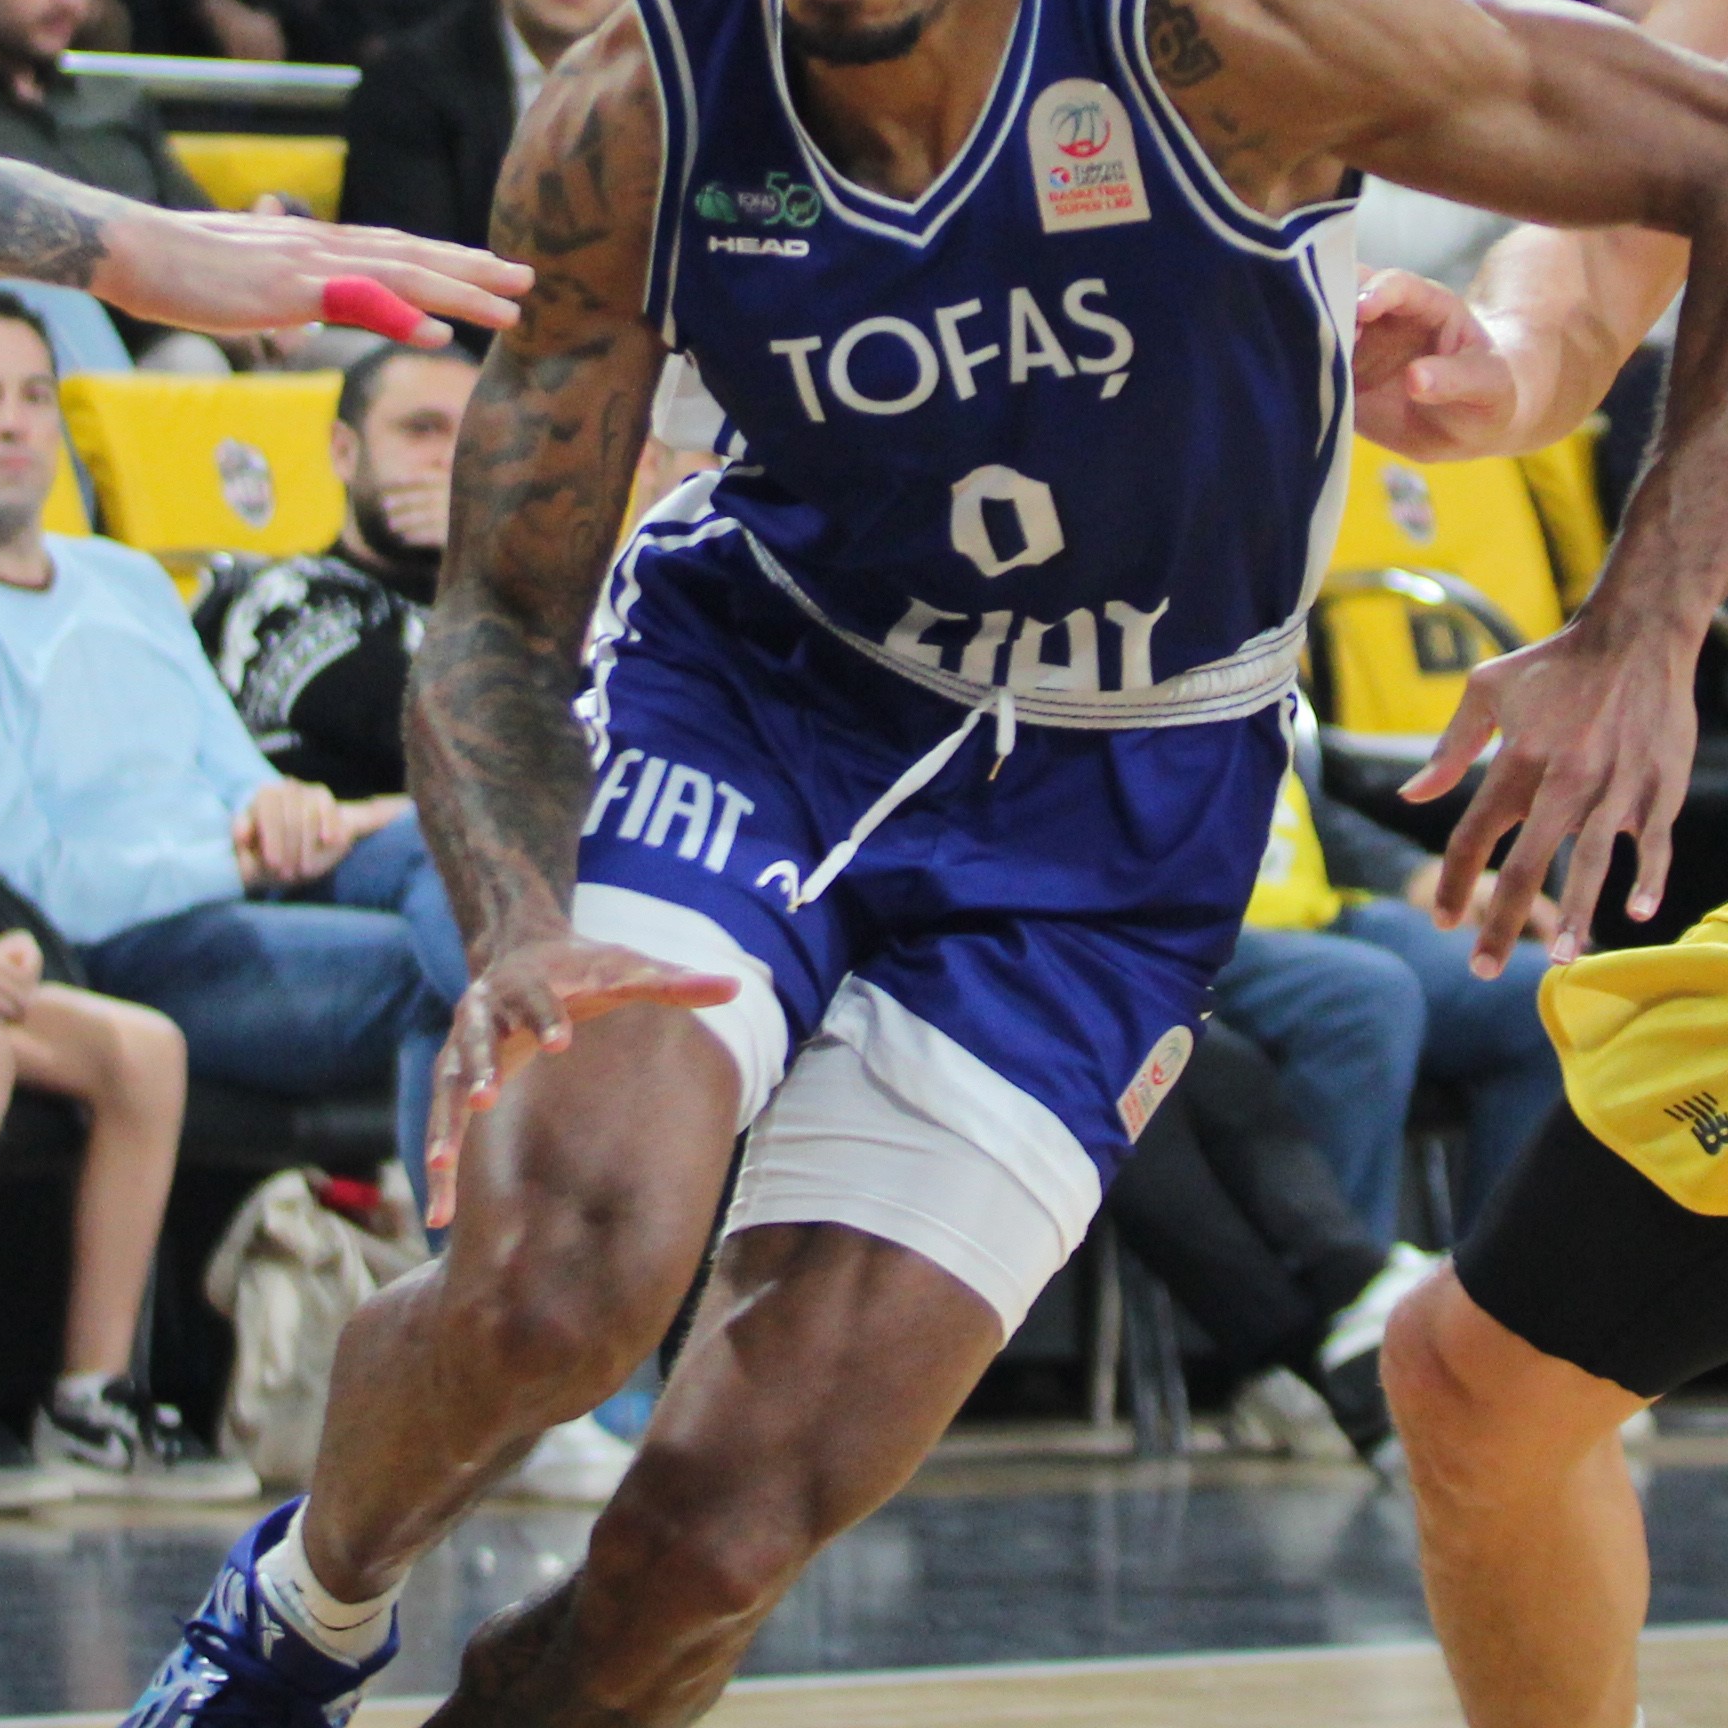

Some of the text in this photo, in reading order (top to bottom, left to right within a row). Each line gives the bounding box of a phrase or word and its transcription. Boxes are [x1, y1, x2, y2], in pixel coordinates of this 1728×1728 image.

[708, 235, 811, 259] HEAD
[770, 278, 1134, 424] TOFAŞ
[950, 463, 1065, 578] 0
[580, 747, 756, 874] FIAT
